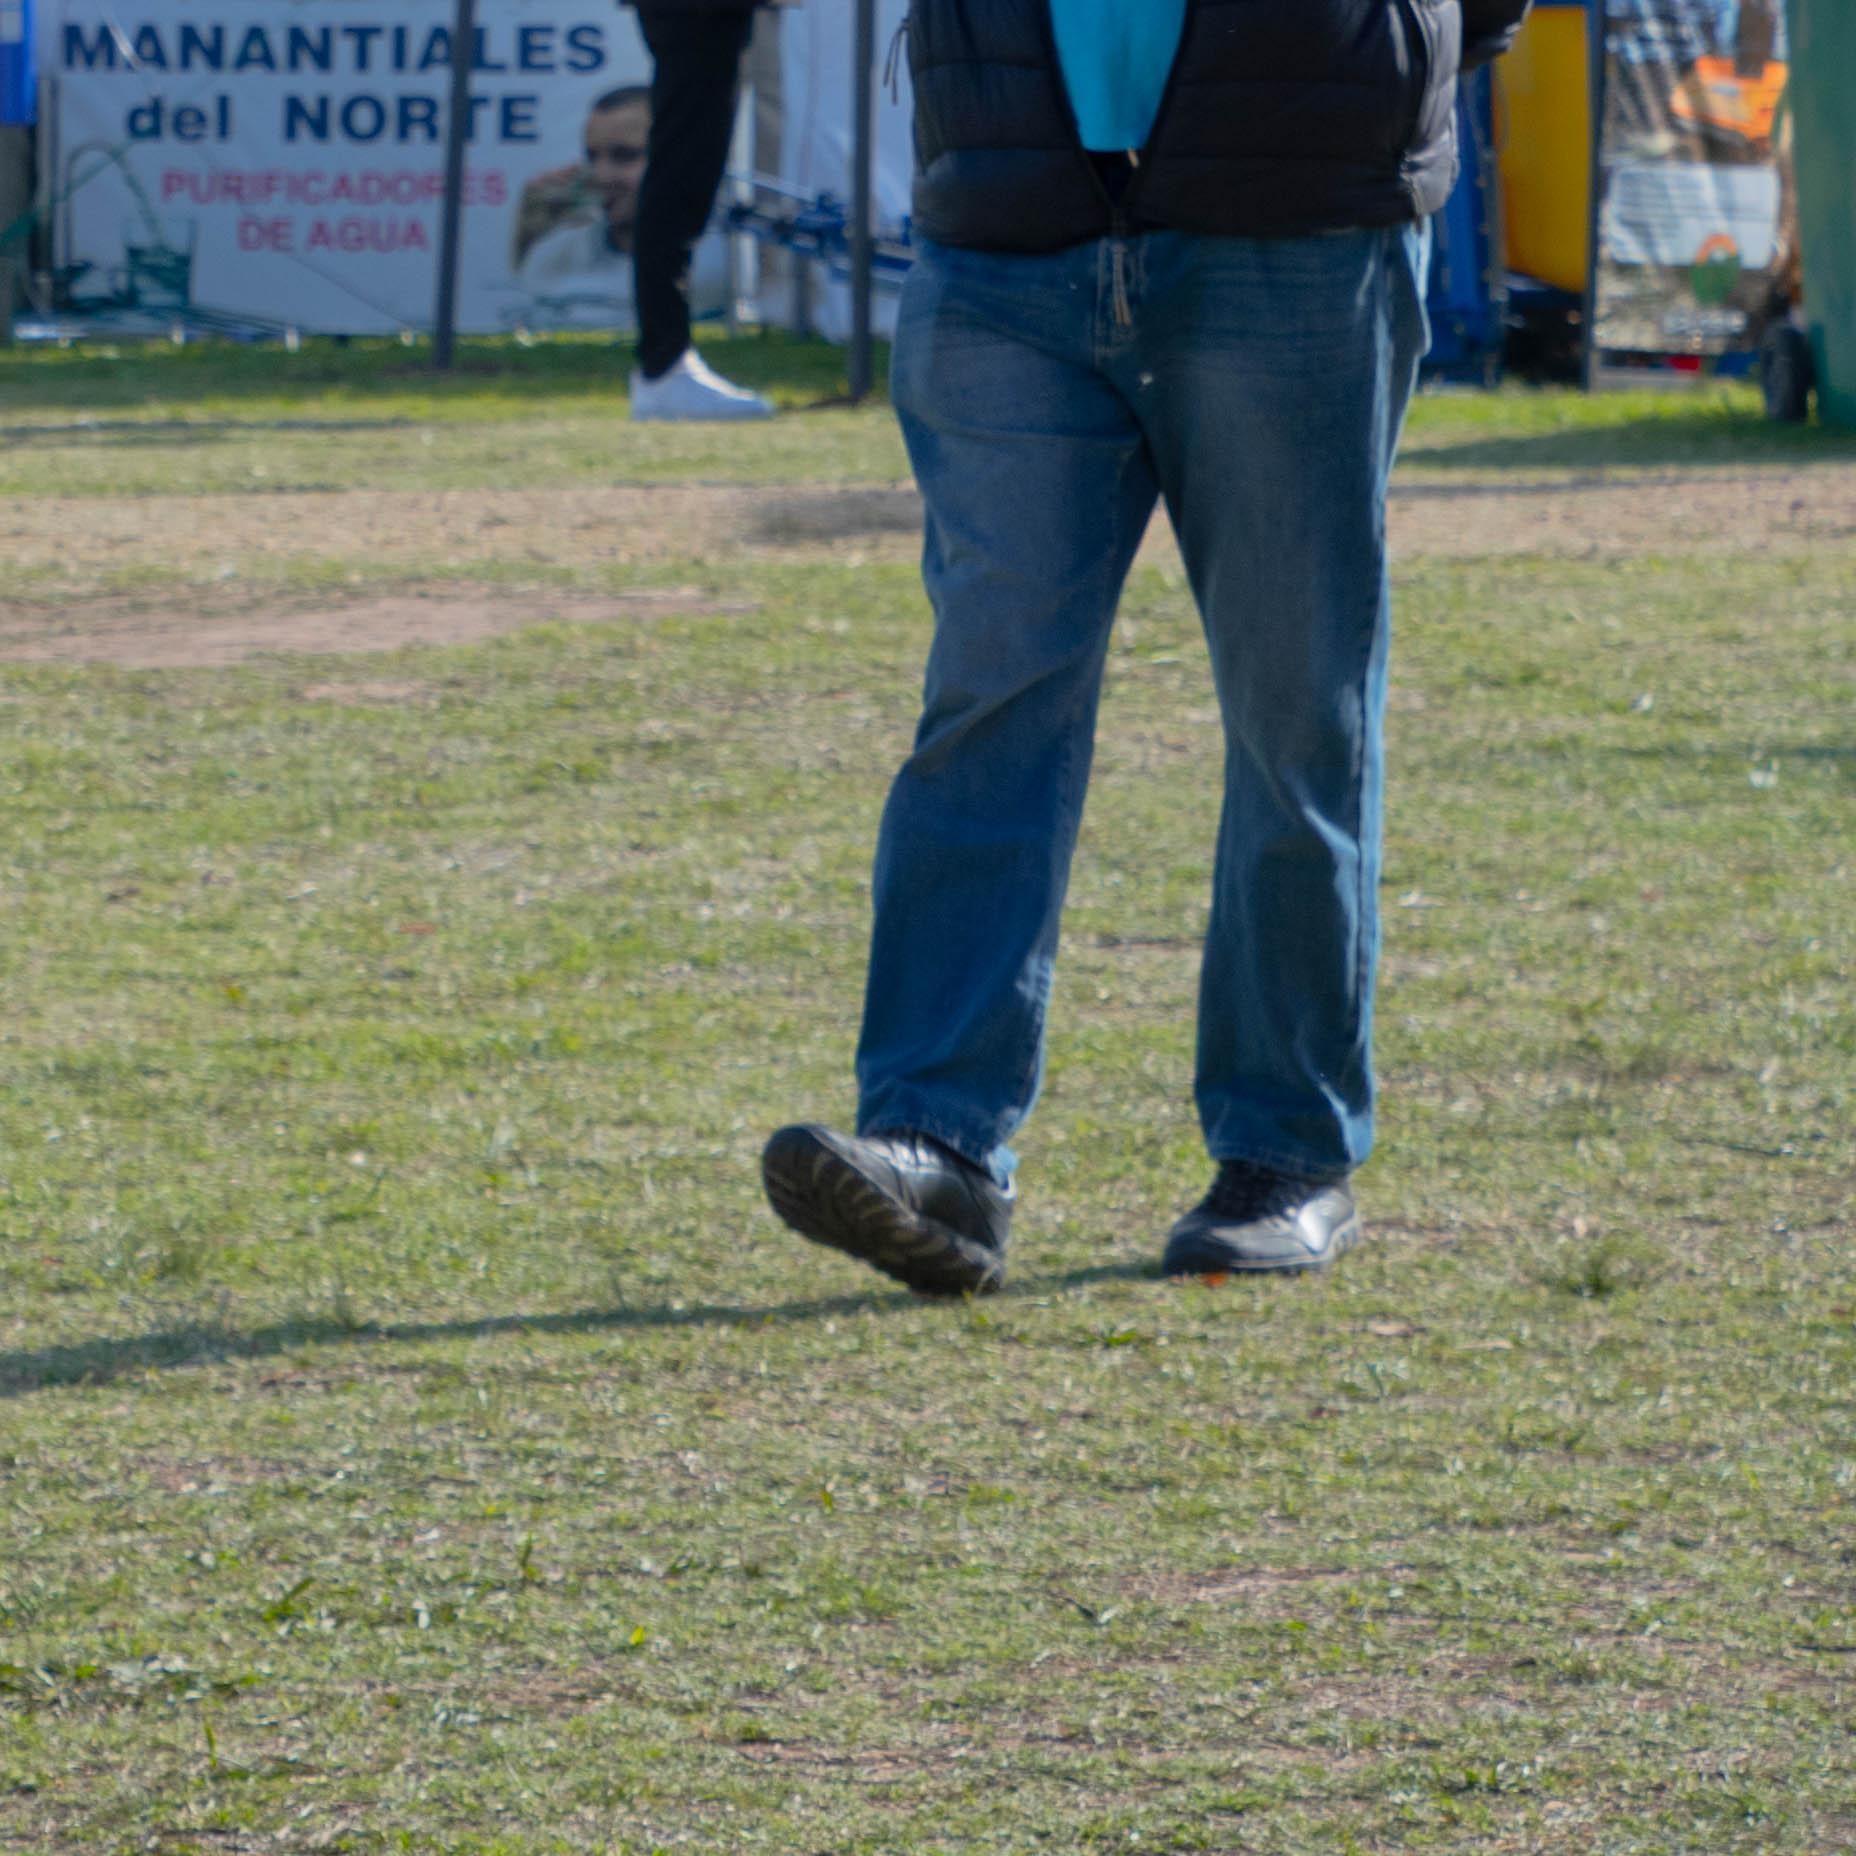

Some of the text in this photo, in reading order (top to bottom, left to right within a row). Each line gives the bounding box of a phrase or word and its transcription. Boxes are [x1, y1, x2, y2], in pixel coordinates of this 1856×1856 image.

[62, 23, 607, 75] MANANTIALES
[126, 93, 540, 144] del NORTE
[236, 215, 431, 254] DE AGUA
